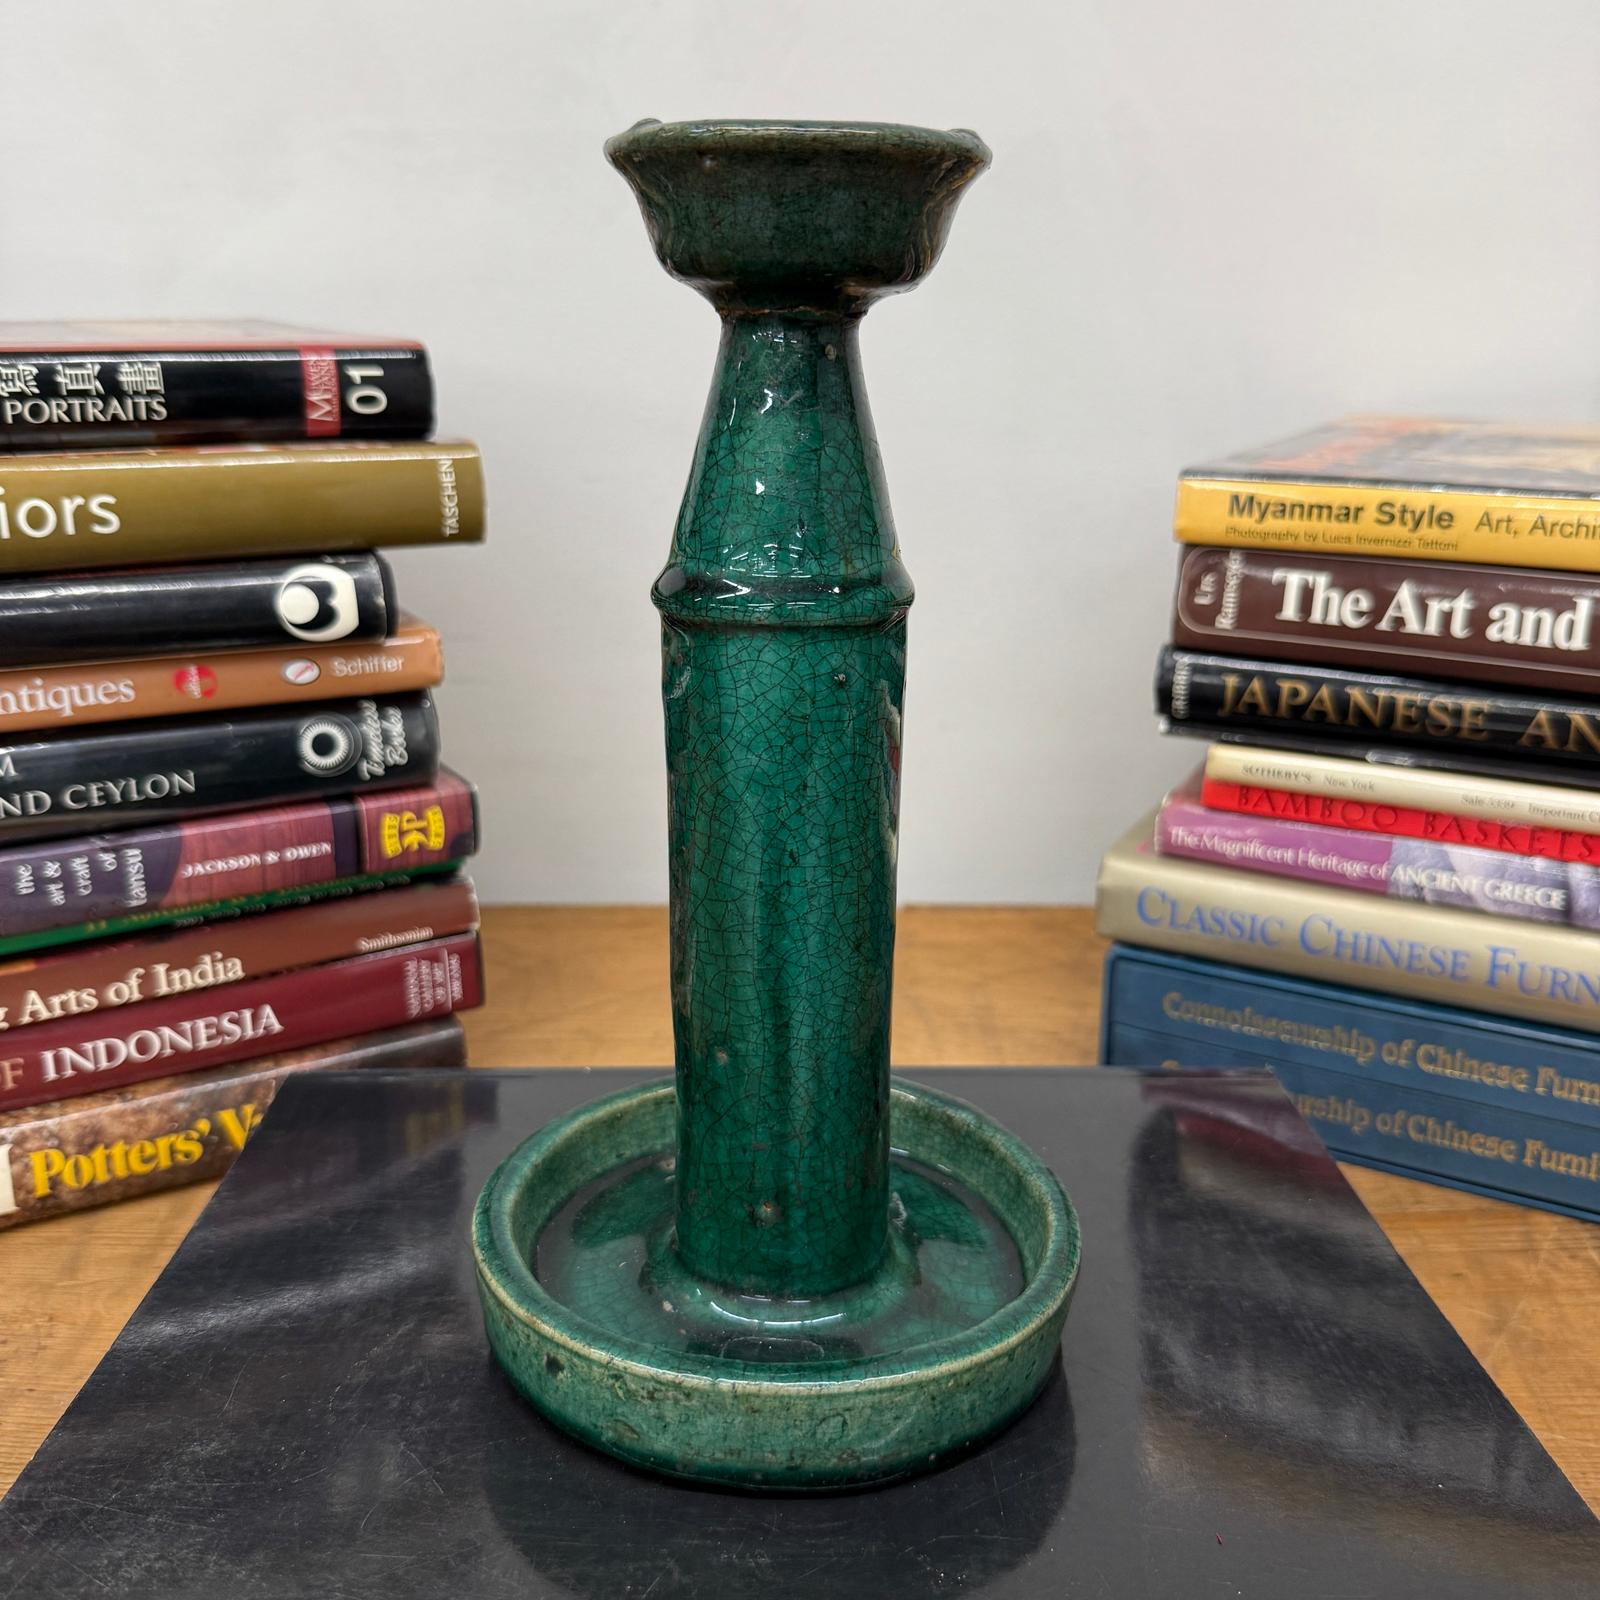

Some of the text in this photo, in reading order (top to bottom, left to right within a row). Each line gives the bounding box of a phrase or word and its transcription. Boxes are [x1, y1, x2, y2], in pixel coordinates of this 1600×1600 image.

[4, 396, 168, 424] PORTRAITS
[345, 364, 388, 415] 01
[0, 486, 121, 539] iors
[438, 457, 460, 537] TASCHEN
[1228, 493, 1364, 525] Myanmar
[1373, 501, 1455, 533] Style
[1474, 510, 1519, 537] Art,
[1225, 525, 1299, 542] Photography
[1303, 530, 1318, 544] by
[1272, 567, 1592, 651] The Art and
[331, 654, 404, 677] Schiffer
[1217, 672, 1489, 741] JAPANESE
[1518, 708, 1600, 751] AN
[62, 769, 196, 810] CEYLON
[1241, 763, 1312, 785] SOTHEBY'S
[1323, 774, 1347, 787] New
[1351, 778, 1375, 793] York
[1237, 785, 1594, 861] BAMBOO BASKETS
[16, 864, 35, 895] the
[181, 841, 332, 879] JACKSON & OWEN
[1168, 826, 1569, 912] The Magnificent Heritage of ANCIENT GREECE
[357, 926, 434, 953] Smithsonian
[1136, 885, 1285, 947] CLASSIC
[1299, 913, 1471, 983] CHINESE
[19, 988, 99, 1026] Arts
[102, 967, 146, 1006] of
[151, 950, 246, 998] India
[40, 1003, 285, 1083] INDONESIA
[1381, 1038, 1417, 1067] of
[1416, 1043, 1530, 1093] Chinese
[217, 1103, 264, 1150] V
[1375, 1110, 1408, 1138] of
[1407, 1114, 1518, 1164] Chinese
